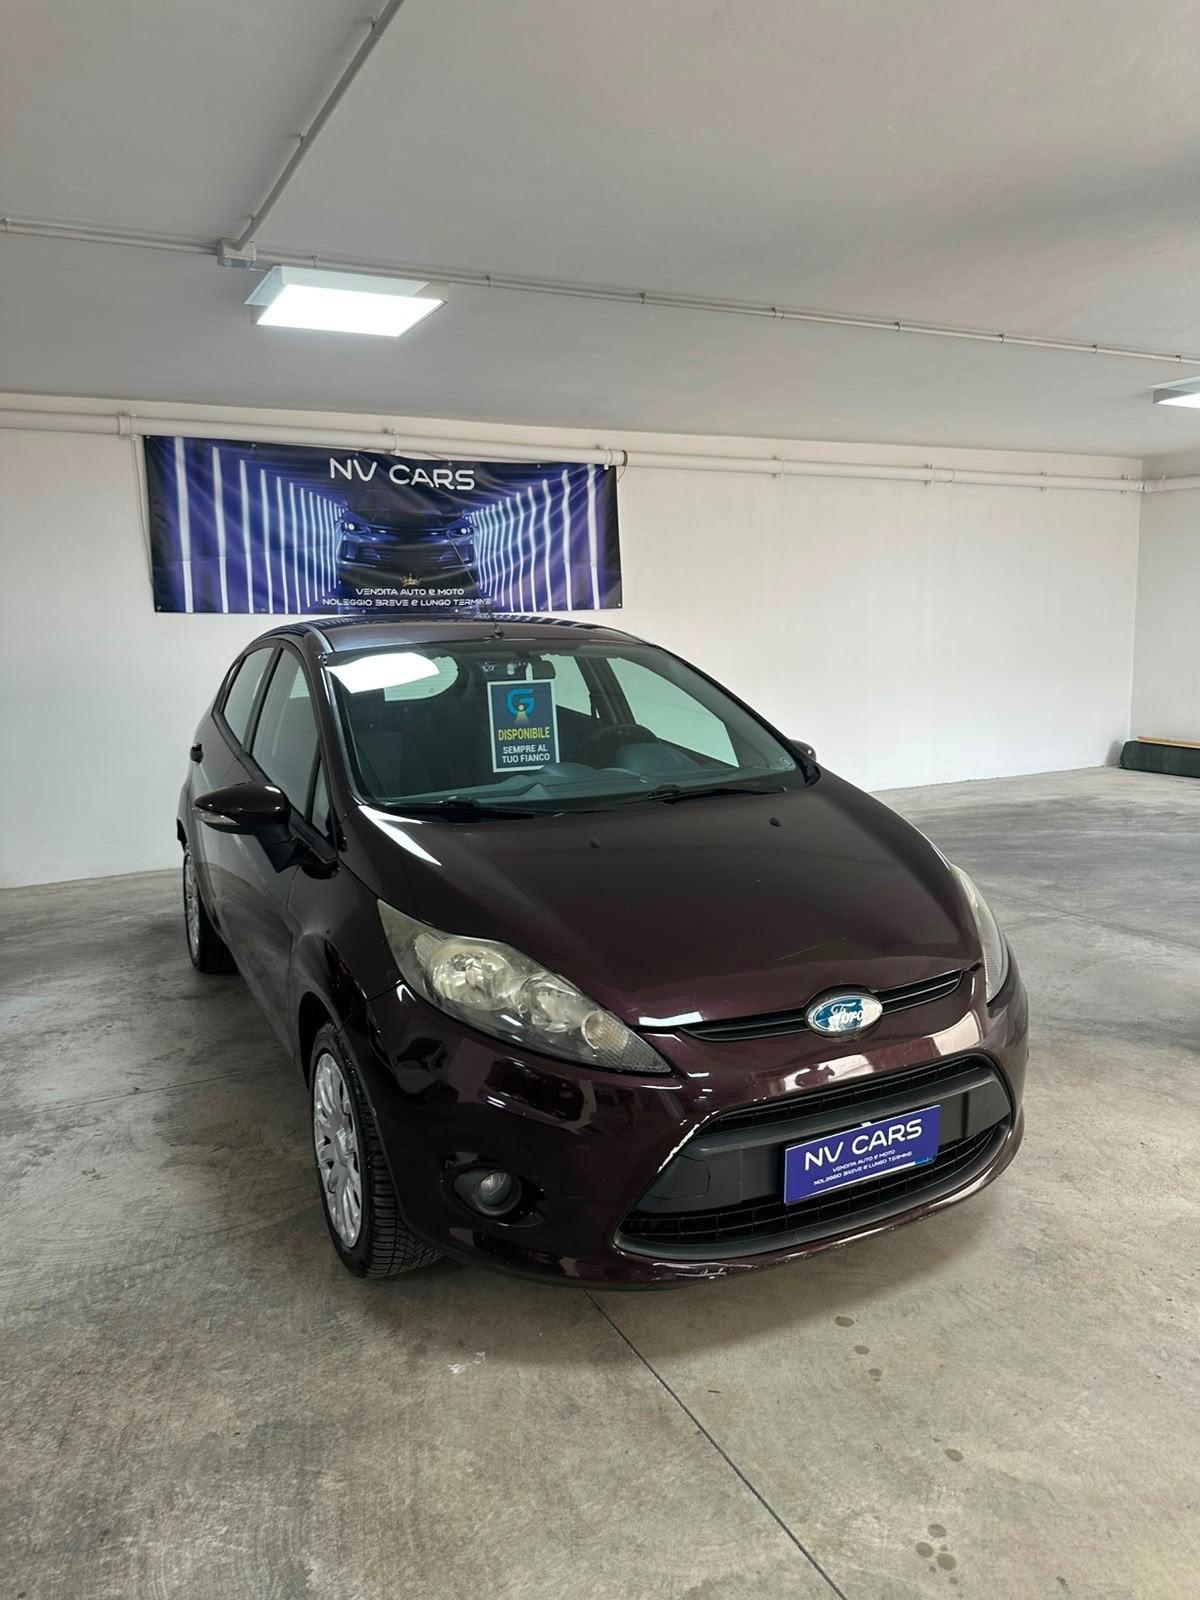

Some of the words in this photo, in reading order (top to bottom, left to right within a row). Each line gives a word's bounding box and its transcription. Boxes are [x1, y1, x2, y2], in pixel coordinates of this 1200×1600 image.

[329, 457, 378, 482] NV
[389, 464, 475, 490] CARS
[355, 587, 399, 596] VENDITA
[400, 588, 426, 596] AUTO
[437, 588, 465, 596] MOTO
[322, 598, 373, 606] NOLEGGIO
[375, 599, 409, 607] BREVE
[452, 597, 492, 606] TERMINE
[498, 726, 551, 741] DISPONIBILE
[503, 744, 536, 755] SEMPRE
[537, 743, 548, 752] AL
[501, 755, 519, 763] TUO
[520, 753, 550, 763] FIANCO
[804, 1141, 844, 1171] NV
[851, 1118, 922, 1155] CARS
[857, 1155, 873, 1164] AUTO
[879, 1149, 896, 1159] MOTO
